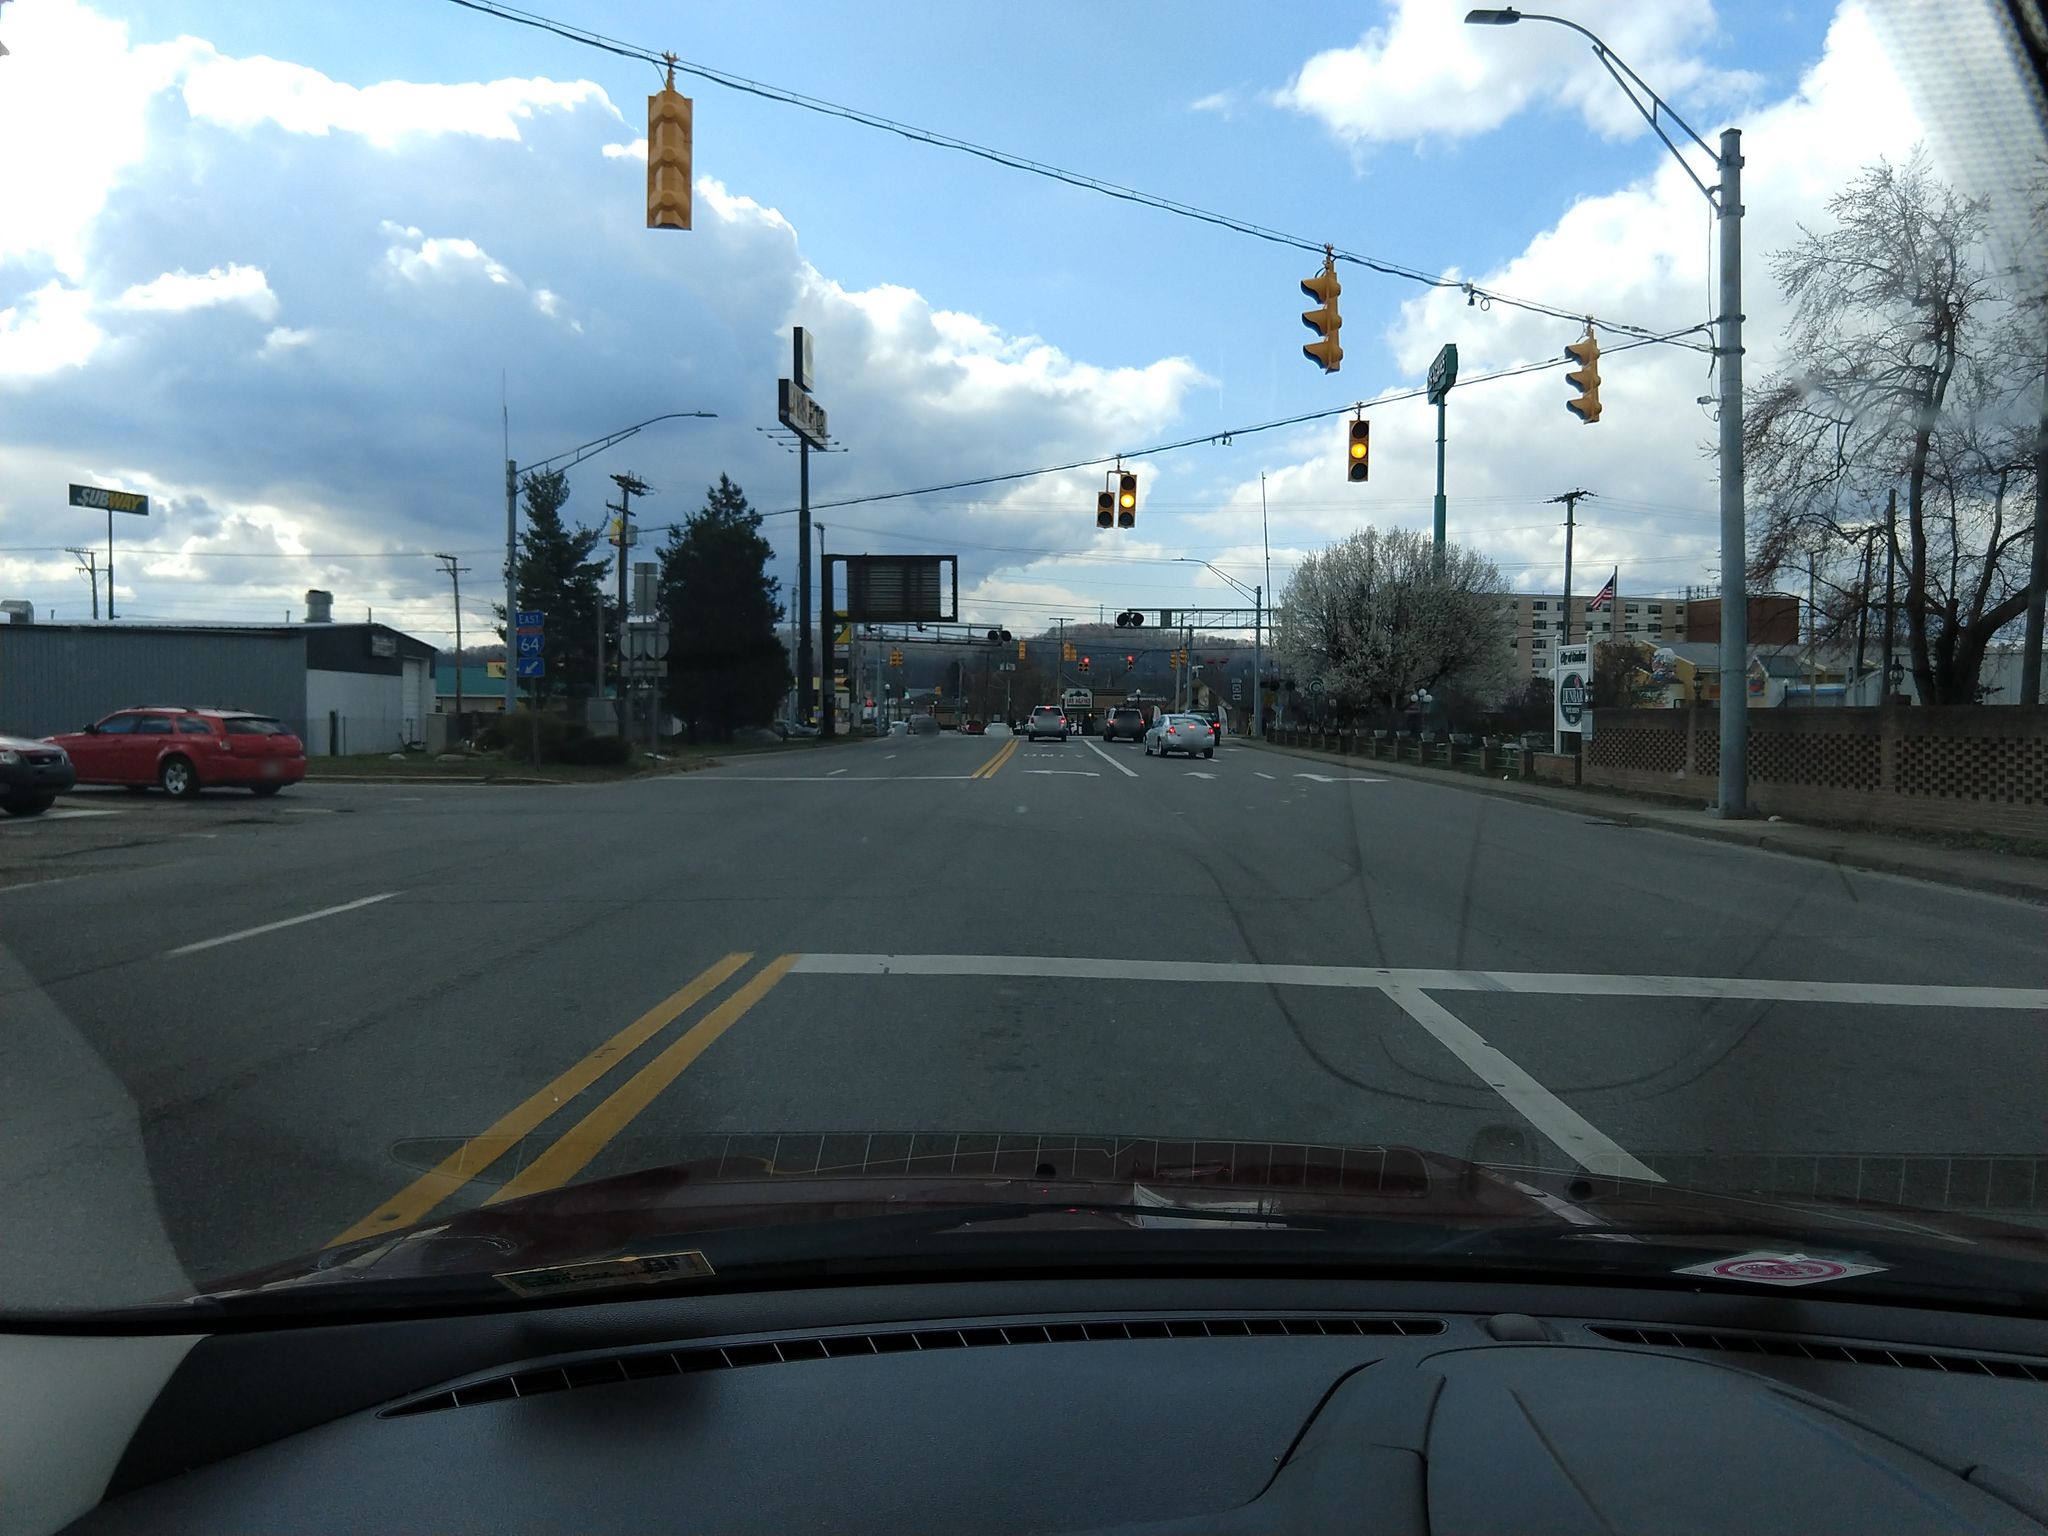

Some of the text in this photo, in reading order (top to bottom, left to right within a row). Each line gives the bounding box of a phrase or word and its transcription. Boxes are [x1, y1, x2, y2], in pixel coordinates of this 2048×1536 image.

[76, 488, 145, 511] SUBWAY
[519, 614, 540, 625] EAST
[520, 637, 540, 652] 64
